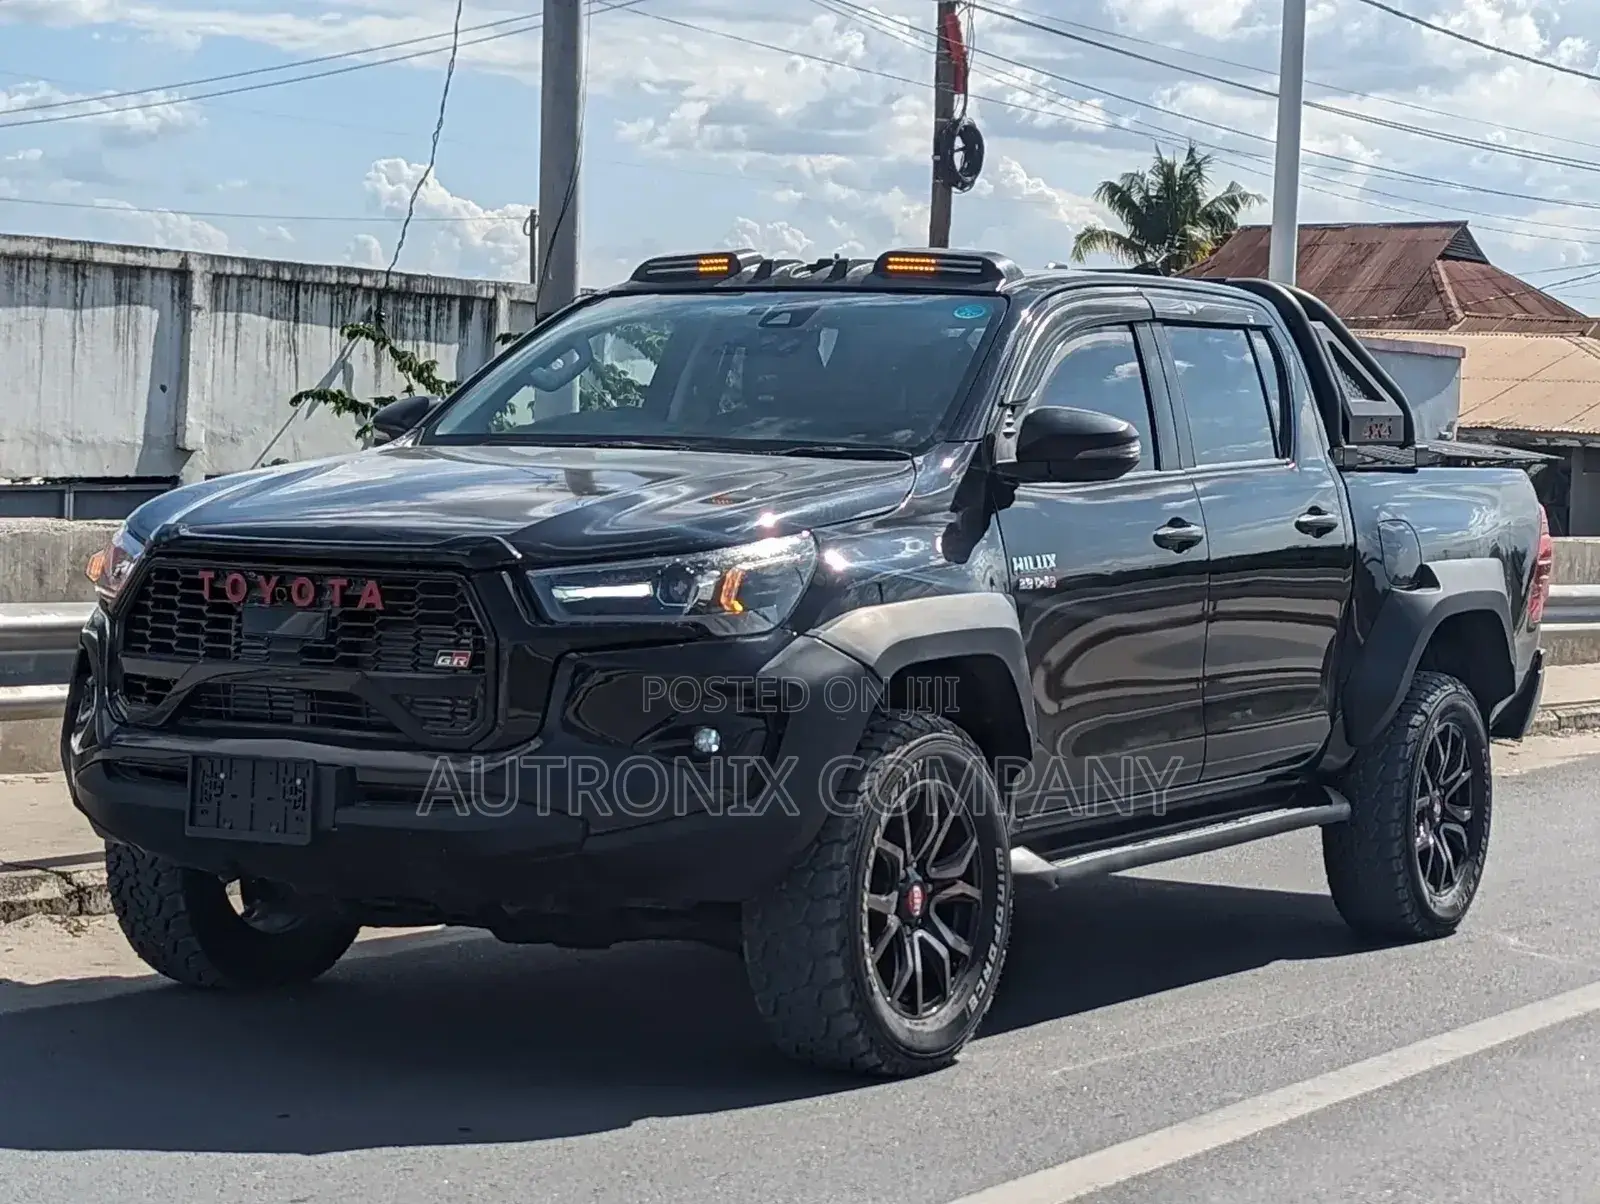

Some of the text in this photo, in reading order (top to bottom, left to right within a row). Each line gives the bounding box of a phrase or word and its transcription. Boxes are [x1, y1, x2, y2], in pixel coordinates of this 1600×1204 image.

[1012, 553, 1056, 571] HILUX
[199, 571, 384, 610] TOYOTA
[436, 652, 470, 668] GR
